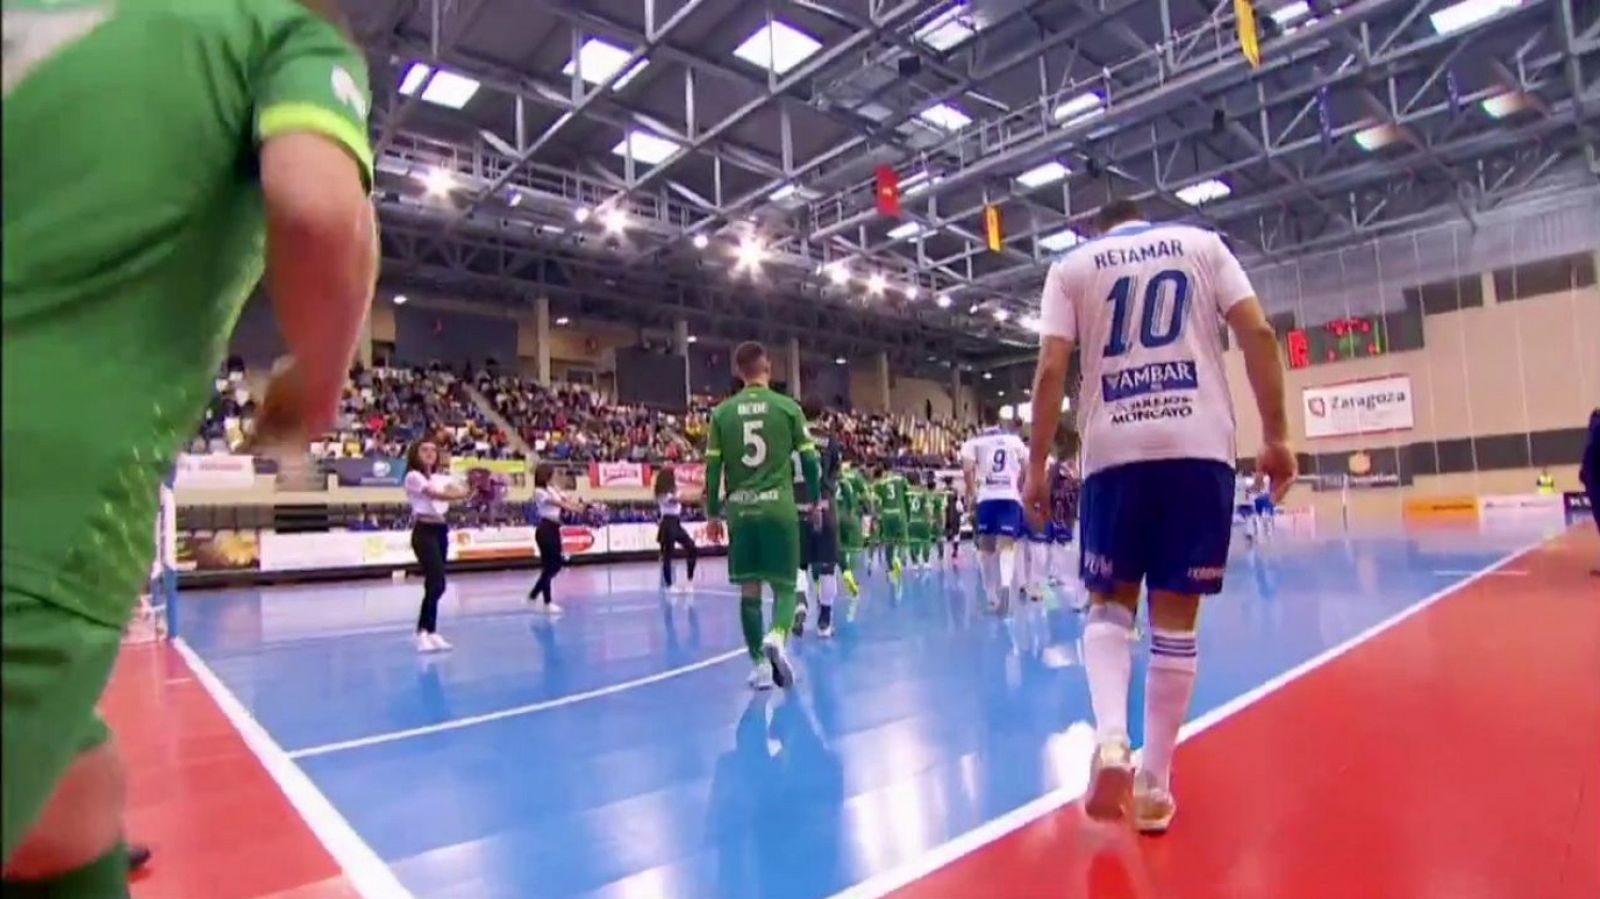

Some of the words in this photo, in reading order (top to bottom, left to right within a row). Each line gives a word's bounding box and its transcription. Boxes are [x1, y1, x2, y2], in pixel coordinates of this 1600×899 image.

[1094, 238, 1185, 270] RETAMAR
[1102, 269, 1190, 357] 10
[1331, 390, 1406, 411] Zaragoza
[1110, 405, 1193, 425] MONCAYO
[741, 420, 767, 468] 5
[992, 448, 1006, 473] 9
[886, 482, 896, 500] 3
